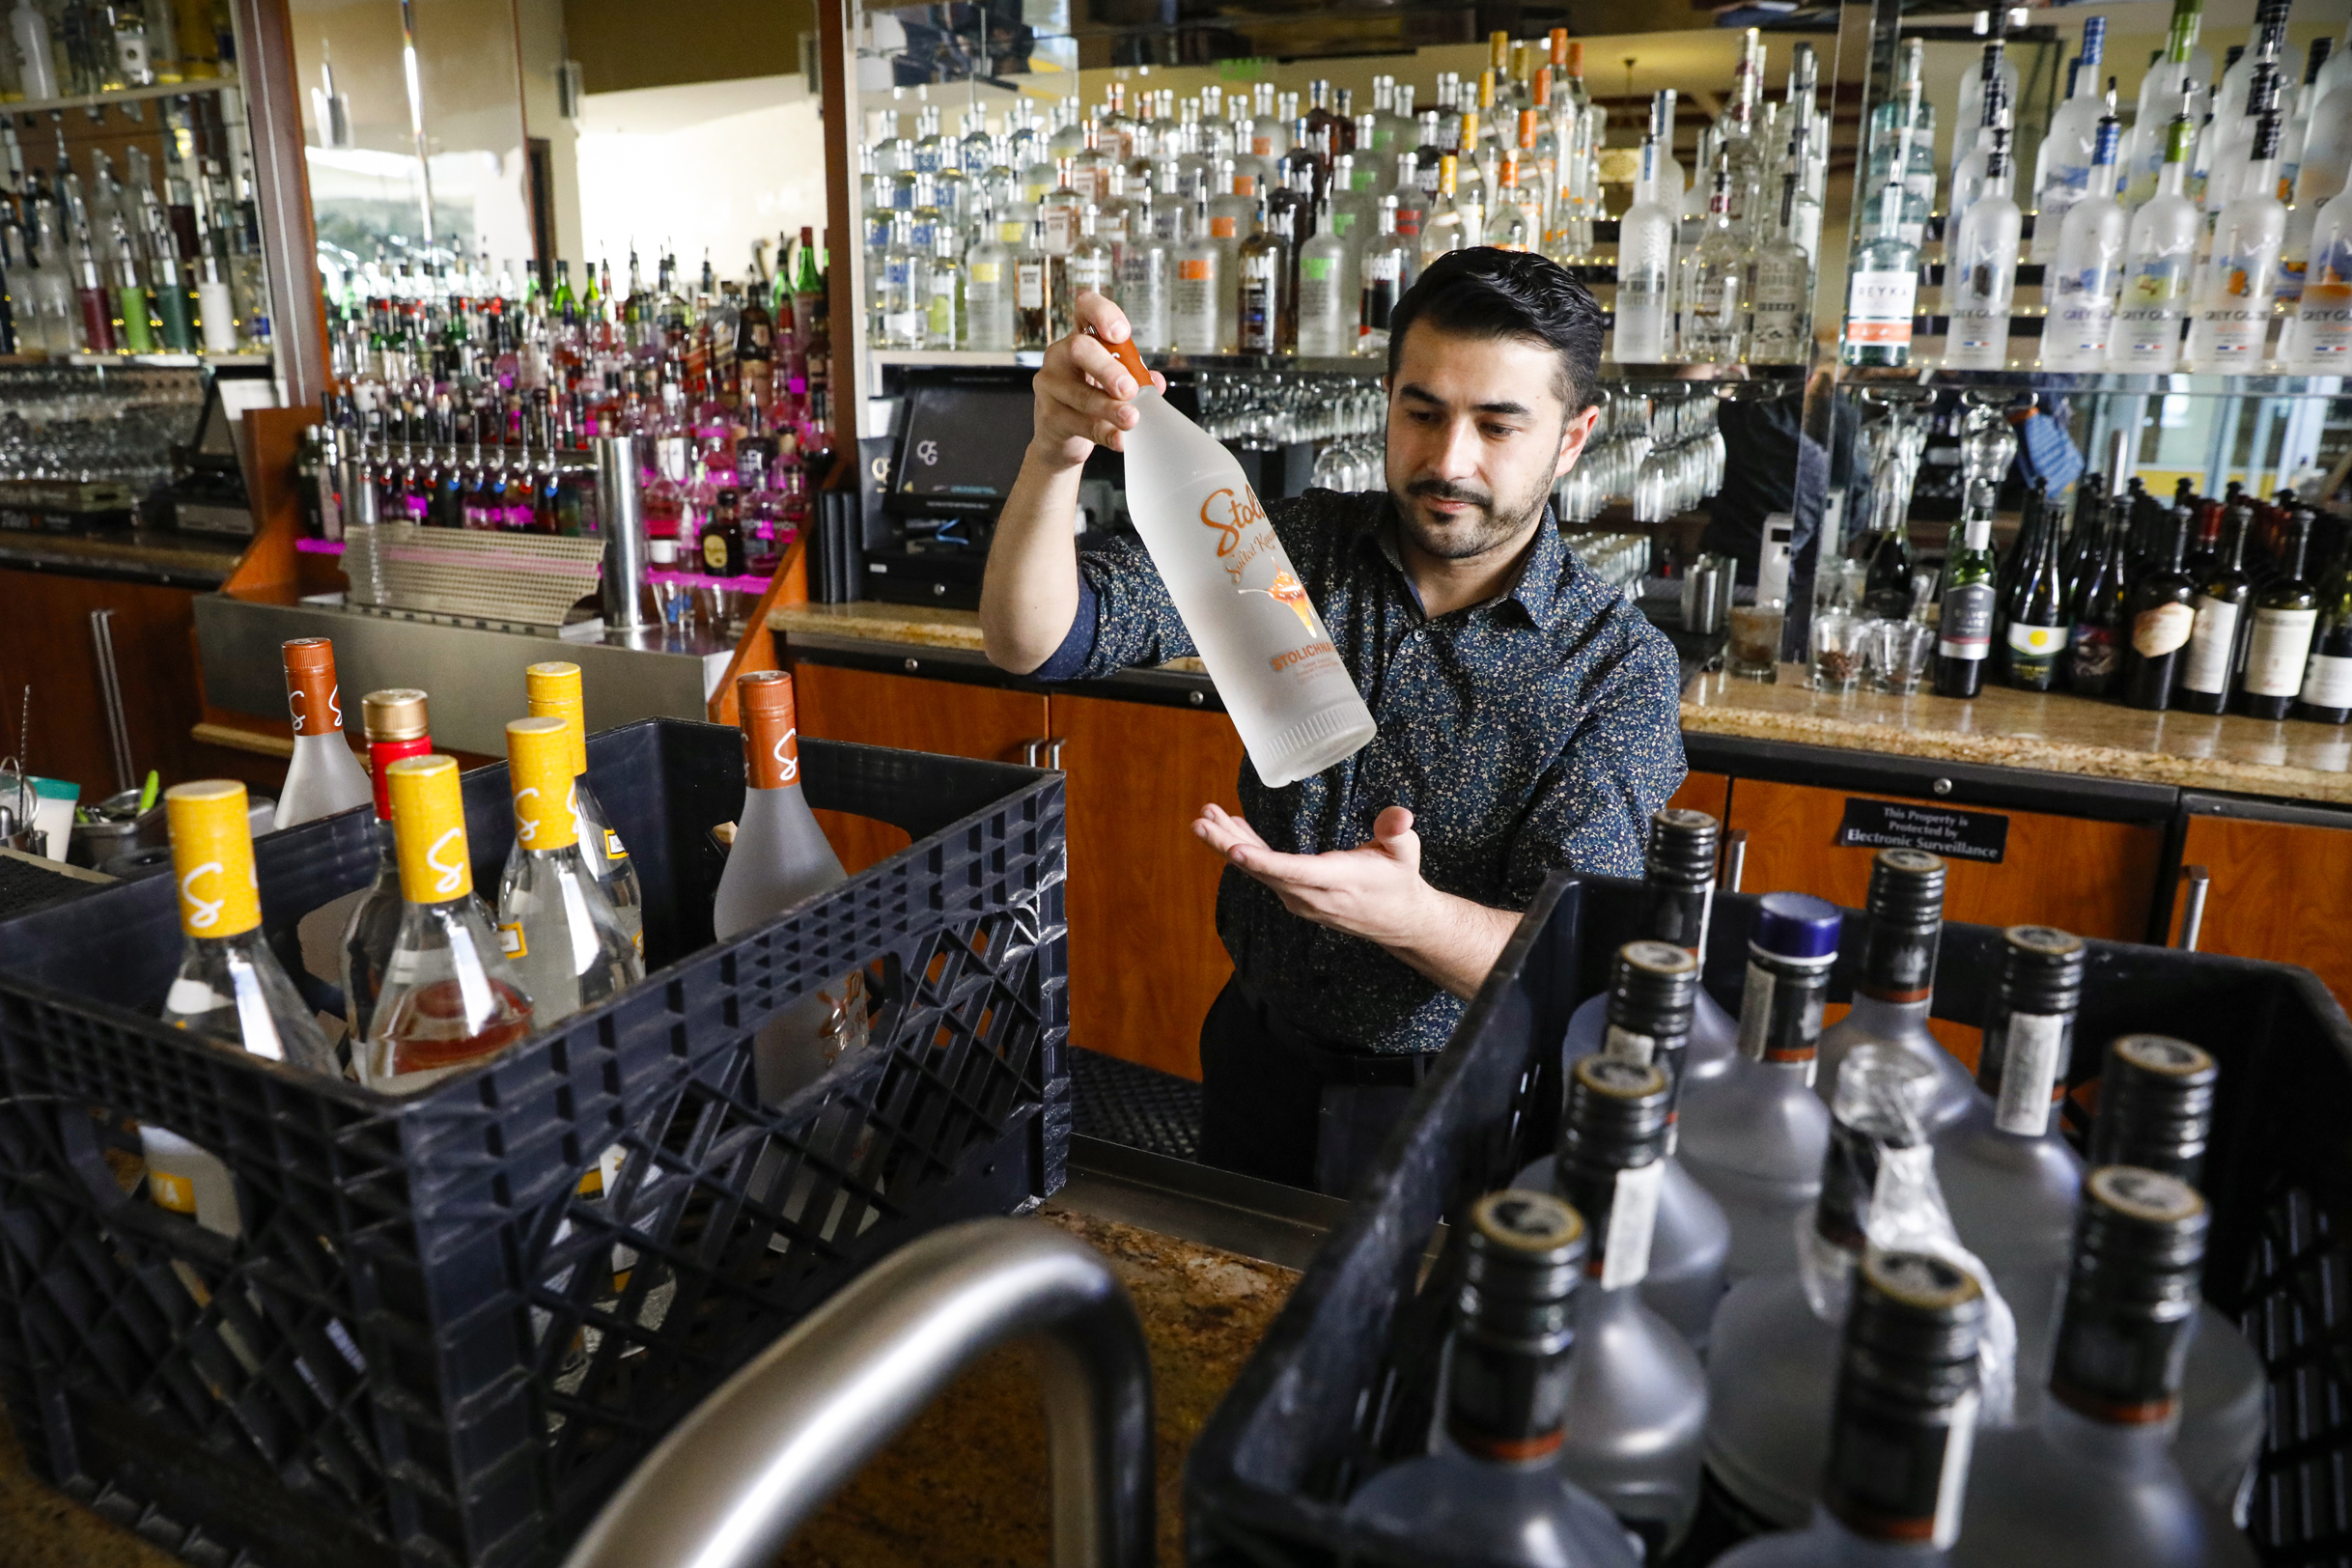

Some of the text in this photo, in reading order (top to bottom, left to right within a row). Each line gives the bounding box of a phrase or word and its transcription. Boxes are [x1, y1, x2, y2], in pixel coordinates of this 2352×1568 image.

[1884, 806, 1969, 827] This Property is
[1889, 821, 1958, 840] Protected by
[1847, 827, 1999, 858] Electronic Surveillance
